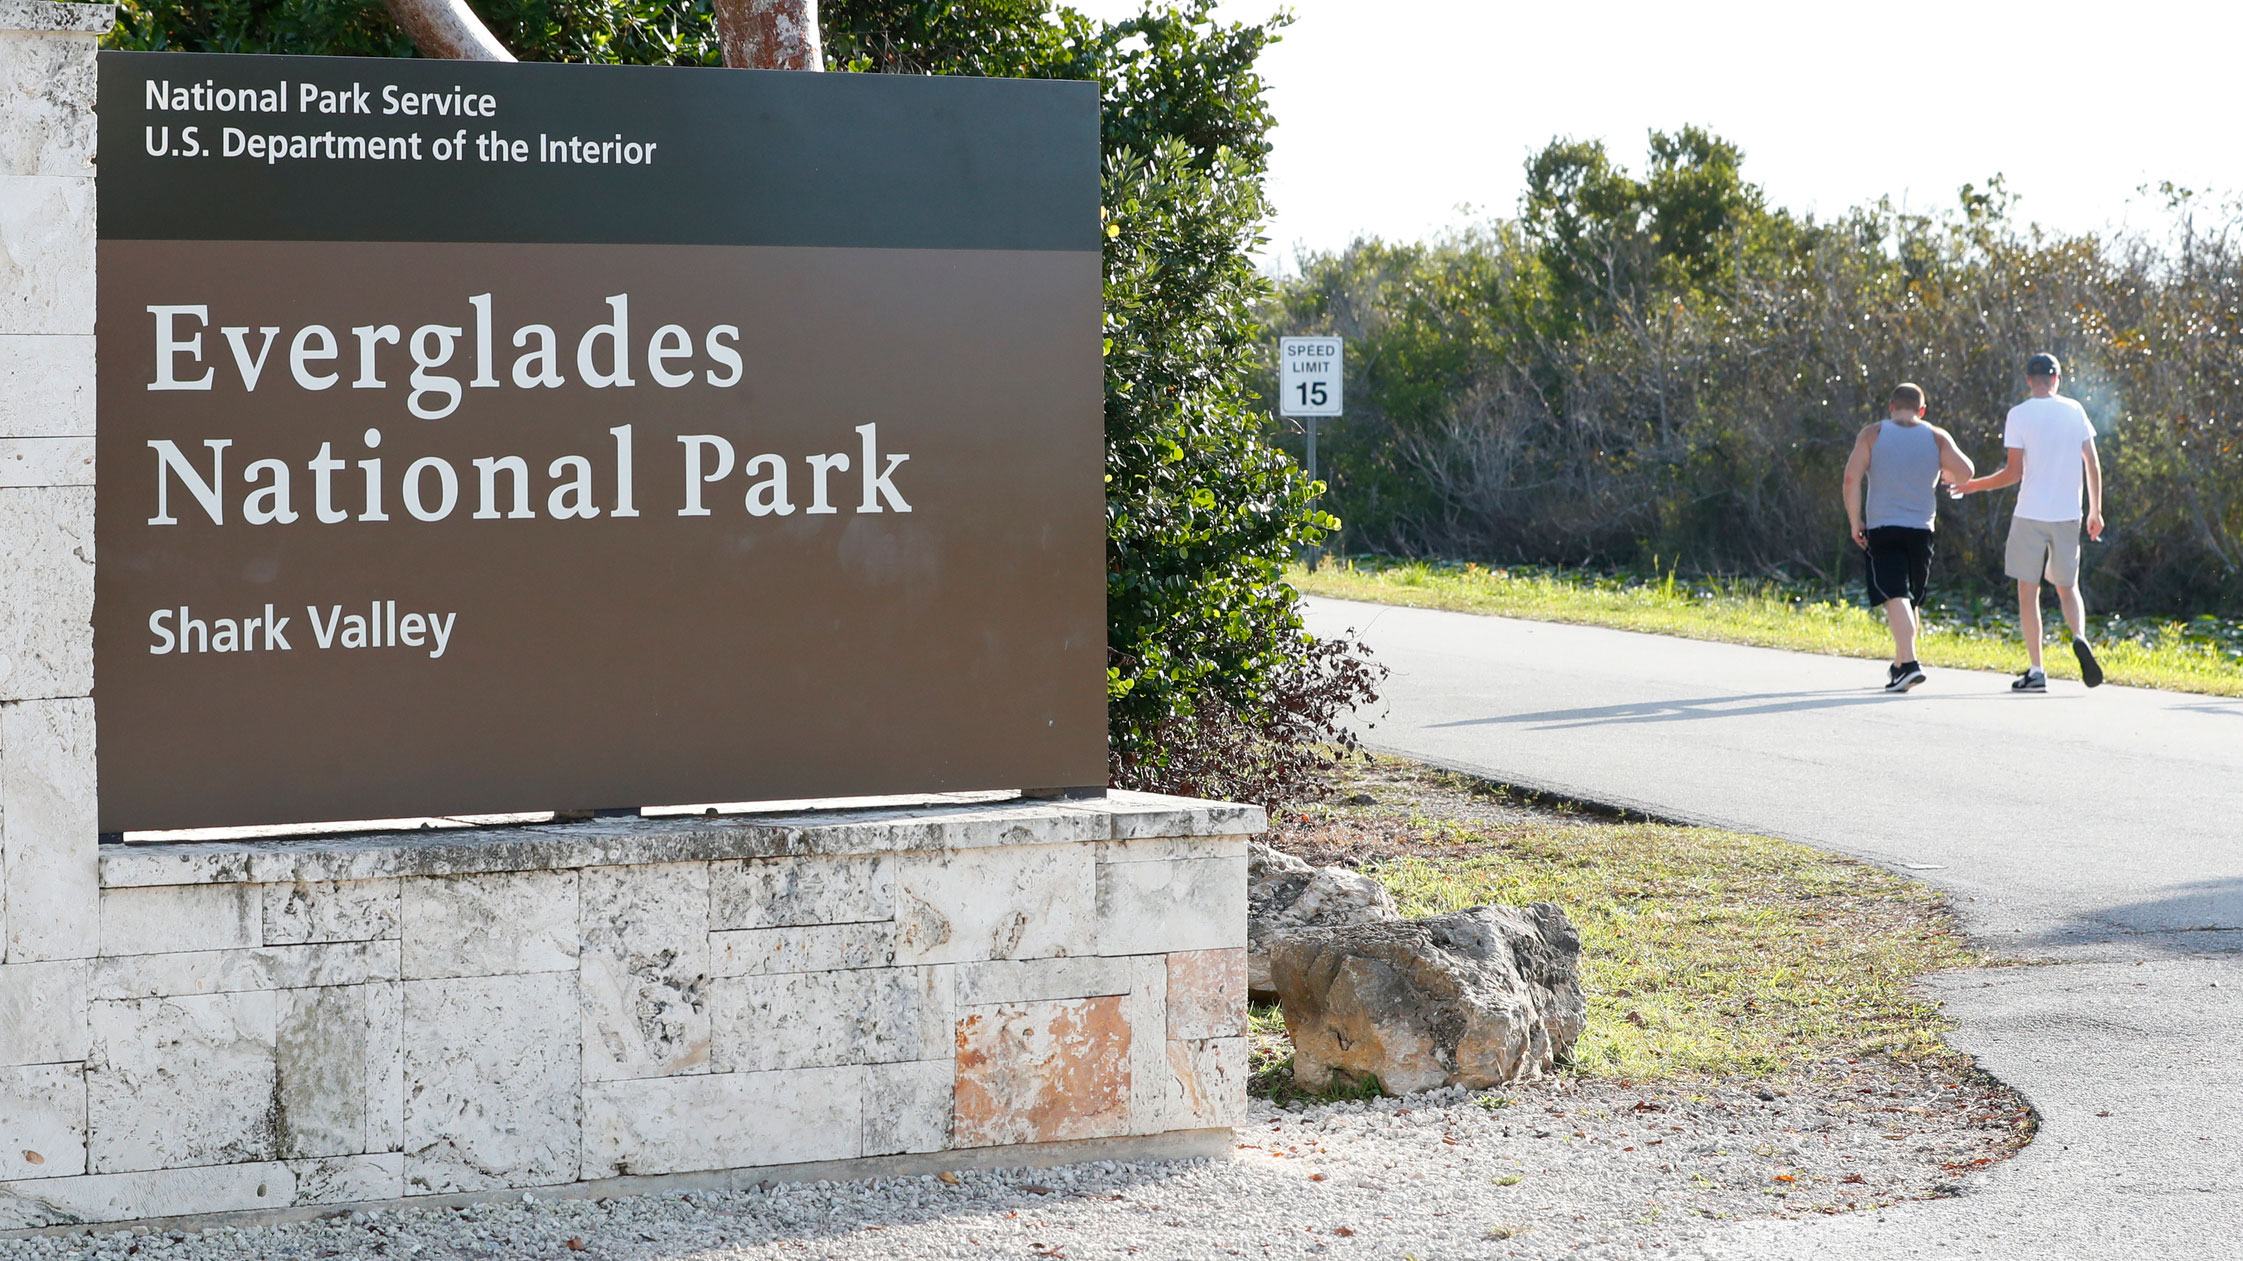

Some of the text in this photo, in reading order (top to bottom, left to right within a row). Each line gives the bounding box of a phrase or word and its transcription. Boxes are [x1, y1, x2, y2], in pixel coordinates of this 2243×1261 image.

[146, 79, 497, 117] National Park Service
[145, 126, 657, 165] U.S. Department of the Interior
[146, 292, 744, 420] Everglades
[1288, 344, 1335, 357] SPEED
[1292, 361, 1330, 373] LIMIT
[1296, 381, 1328, 406] 15
[147, 421, 913, 526] National Park
[148, 600, 457, 659] Shark Valley
